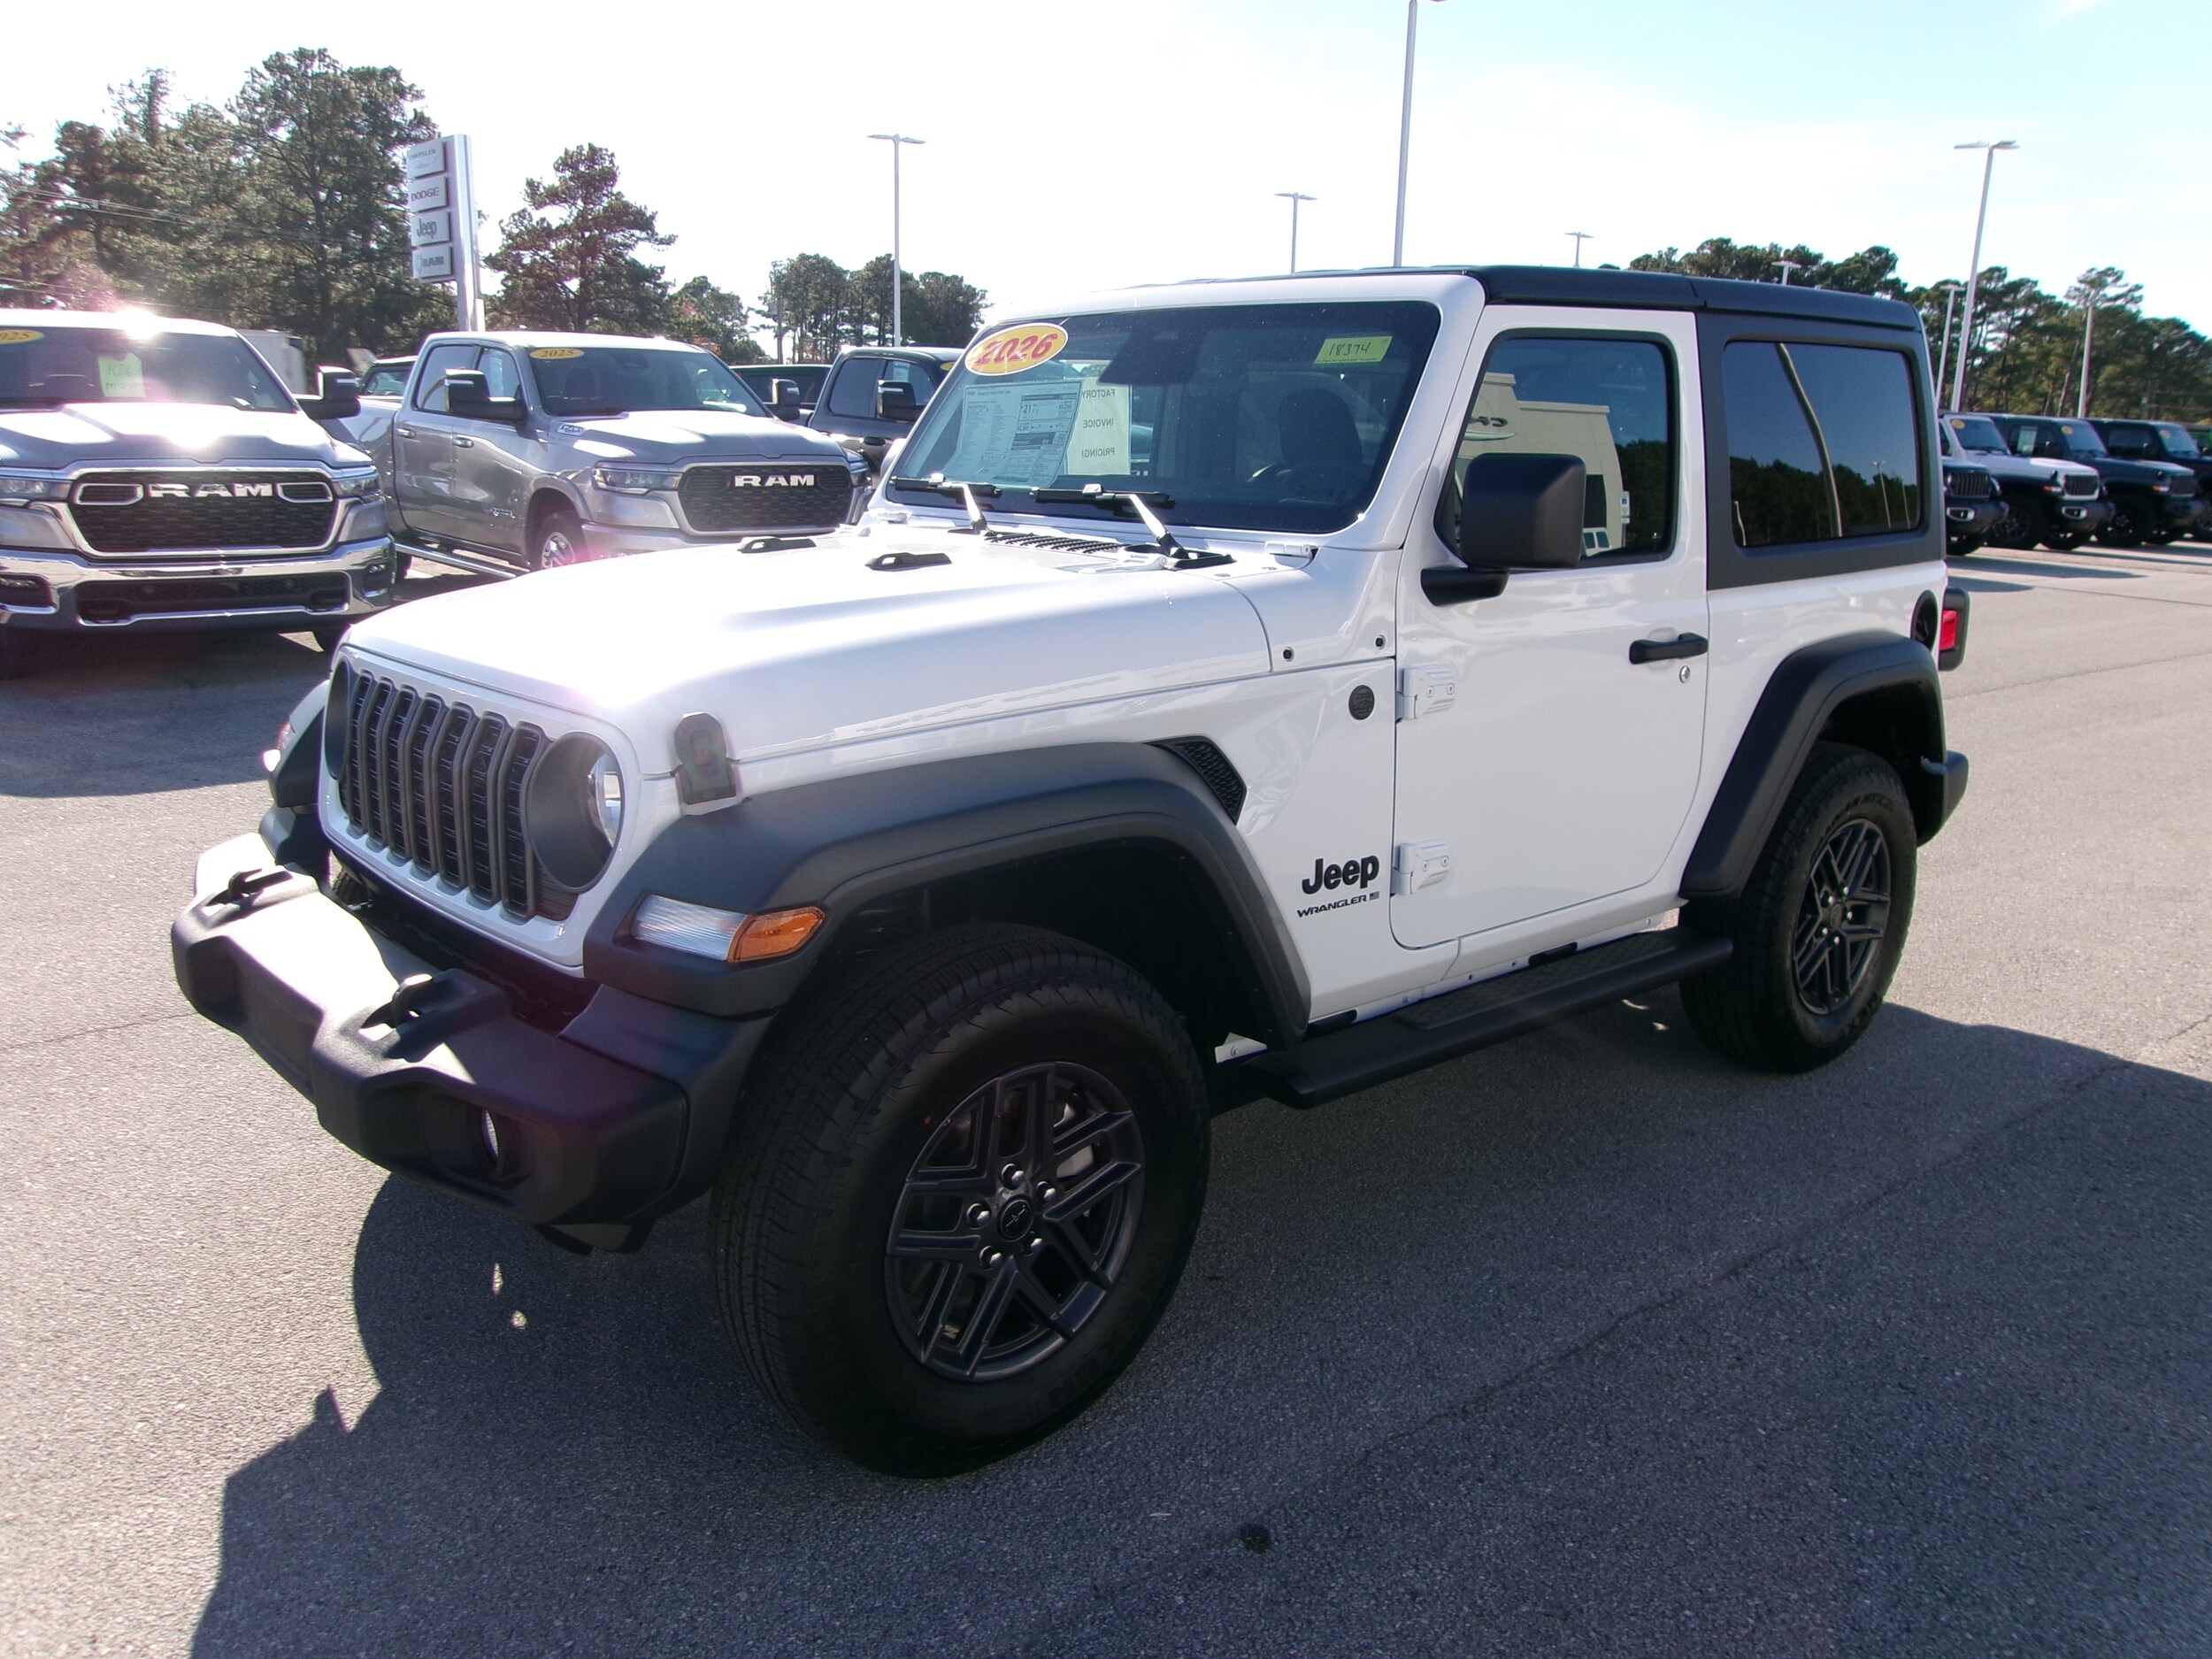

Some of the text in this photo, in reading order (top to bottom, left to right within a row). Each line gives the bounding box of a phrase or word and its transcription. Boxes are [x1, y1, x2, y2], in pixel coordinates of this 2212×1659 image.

[411, 187, 440, 202] DODGE
[417, 219, 437, 239] Jeep
[0, 331, 30, 341] 025
[974, 333, 1059, 365] 2026
[1329, 341, 1371, 356] 18374
[734, 474, 815, 487] RAM
[149, 483, 273, 497] RAM
[1302, 855, 1379, 895] Jeep
[1296, 895, 1367, 918] WRANGLER
